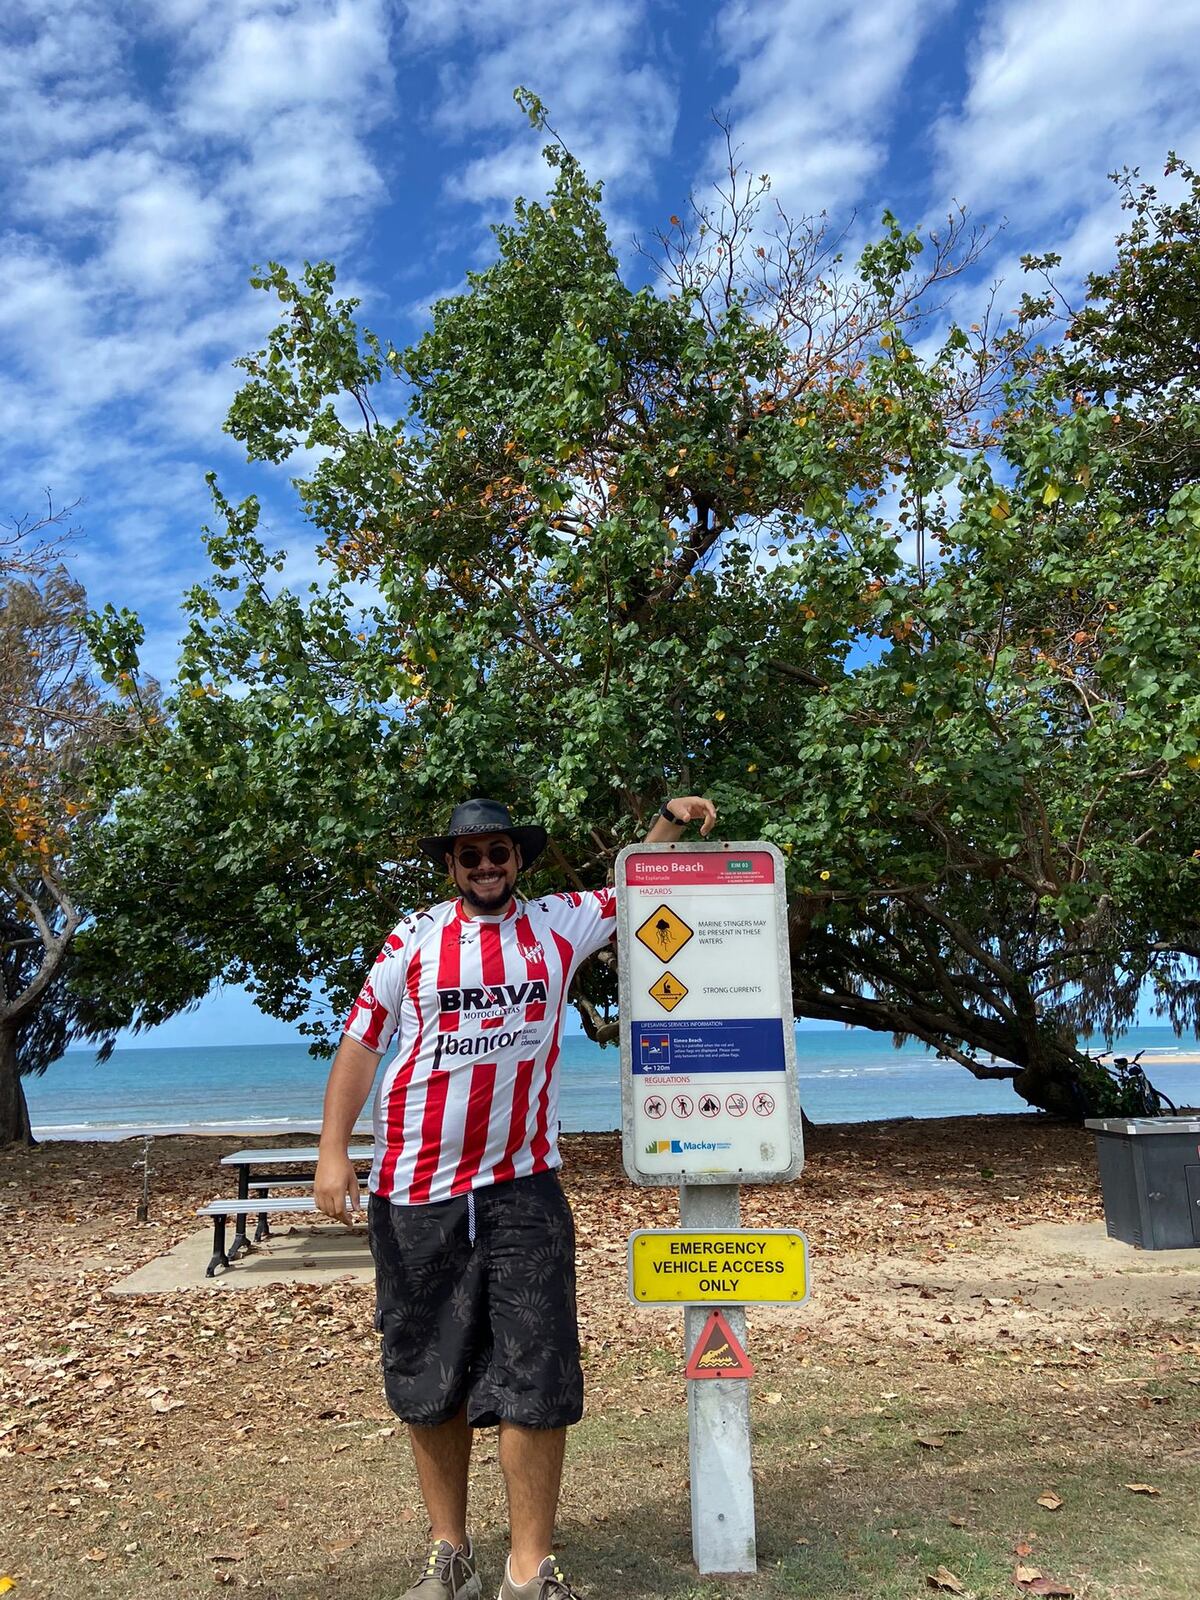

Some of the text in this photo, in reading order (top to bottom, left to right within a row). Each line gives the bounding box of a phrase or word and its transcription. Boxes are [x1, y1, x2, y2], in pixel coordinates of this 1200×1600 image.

[635, 862, 704, 872] Eimeo Beach
[437, 980, 547, 1012] BRAVA
[684, 1140, 716, 1151] Mackay
[670, 1242, 766, 1254] EMERGENCY
[653, 1260, 784, 1274] VEHICLE ACCESS
[700, 1280, 740, 1292] ONLY
